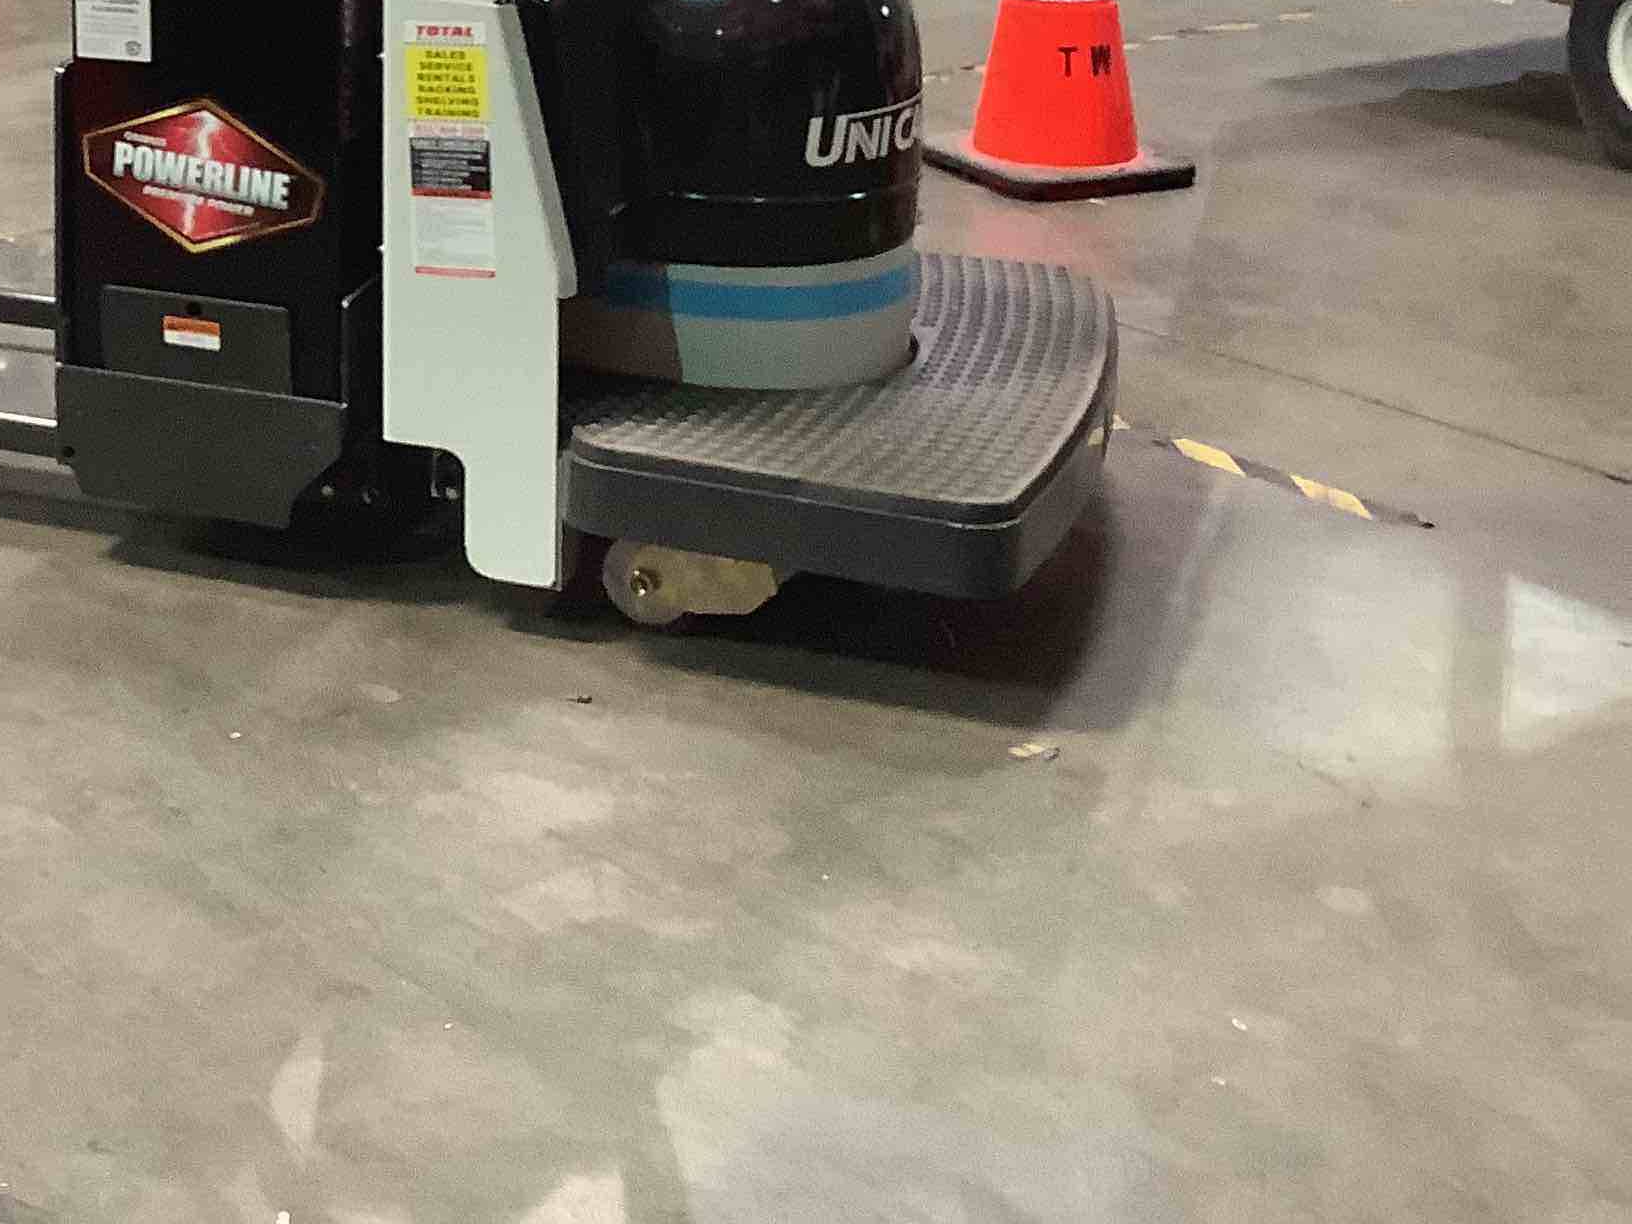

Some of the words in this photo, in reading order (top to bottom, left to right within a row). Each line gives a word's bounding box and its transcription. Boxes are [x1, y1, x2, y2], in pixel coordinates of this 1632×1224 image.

[416, 25, 473, 37] TOTAL
[425, 50, 465, 60] SALES
[419, 62, 472, 71] SERVICE
[416, 73, 475, 83] RENTALS
[417, 107, 480, 118] TRAINING
[113, 140, 292, 210] POWERLINE
